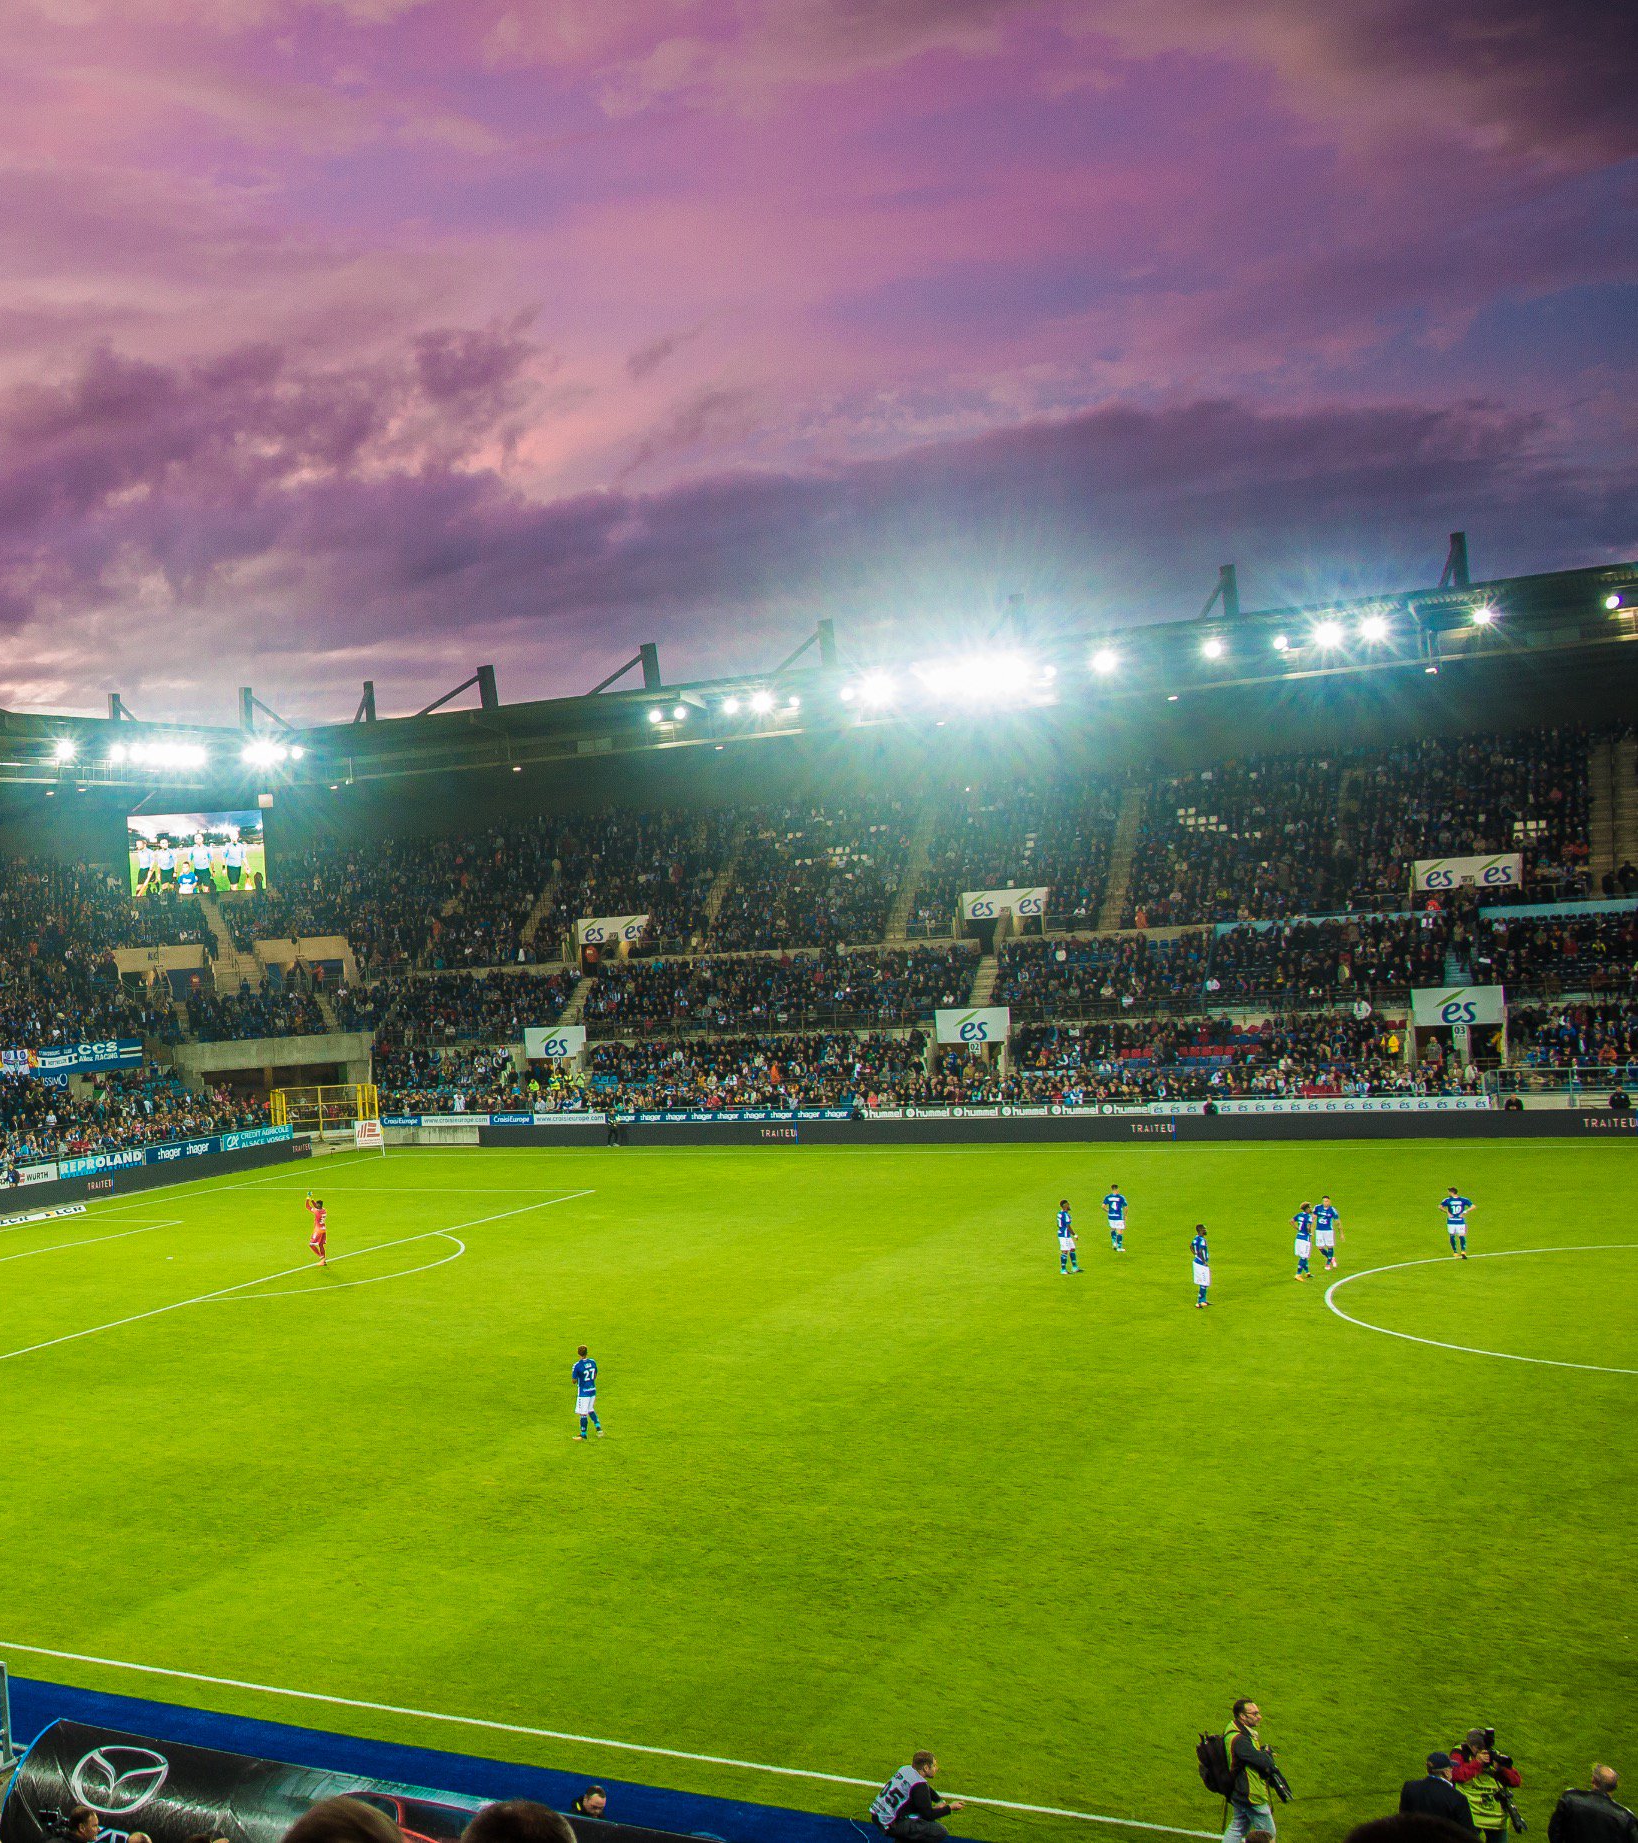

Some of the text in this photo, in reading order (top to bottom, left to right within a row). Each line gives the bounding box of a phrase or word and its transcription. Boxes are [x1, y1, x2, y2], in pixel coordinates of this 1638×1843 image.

[1454, 1026, 1466, 1035] 03
[78, 1042, 118, 1055] CCS
[869, 1108, 903, 1118] hummel
[916, 1107, 950, 1118] hummel
[964, 1107, 998, 1117] hummel
[1012, 1106, 1048, 1116] hummel
[1062, 1105, 1099, 1115] hummel
[1114, 1104, 1151, 1115] hummel
[61, 1150, 142, 1174] REPROLAND
[1451, 1205, 1462, 1215] 10
[583, 1368, 596, 1381] 27
